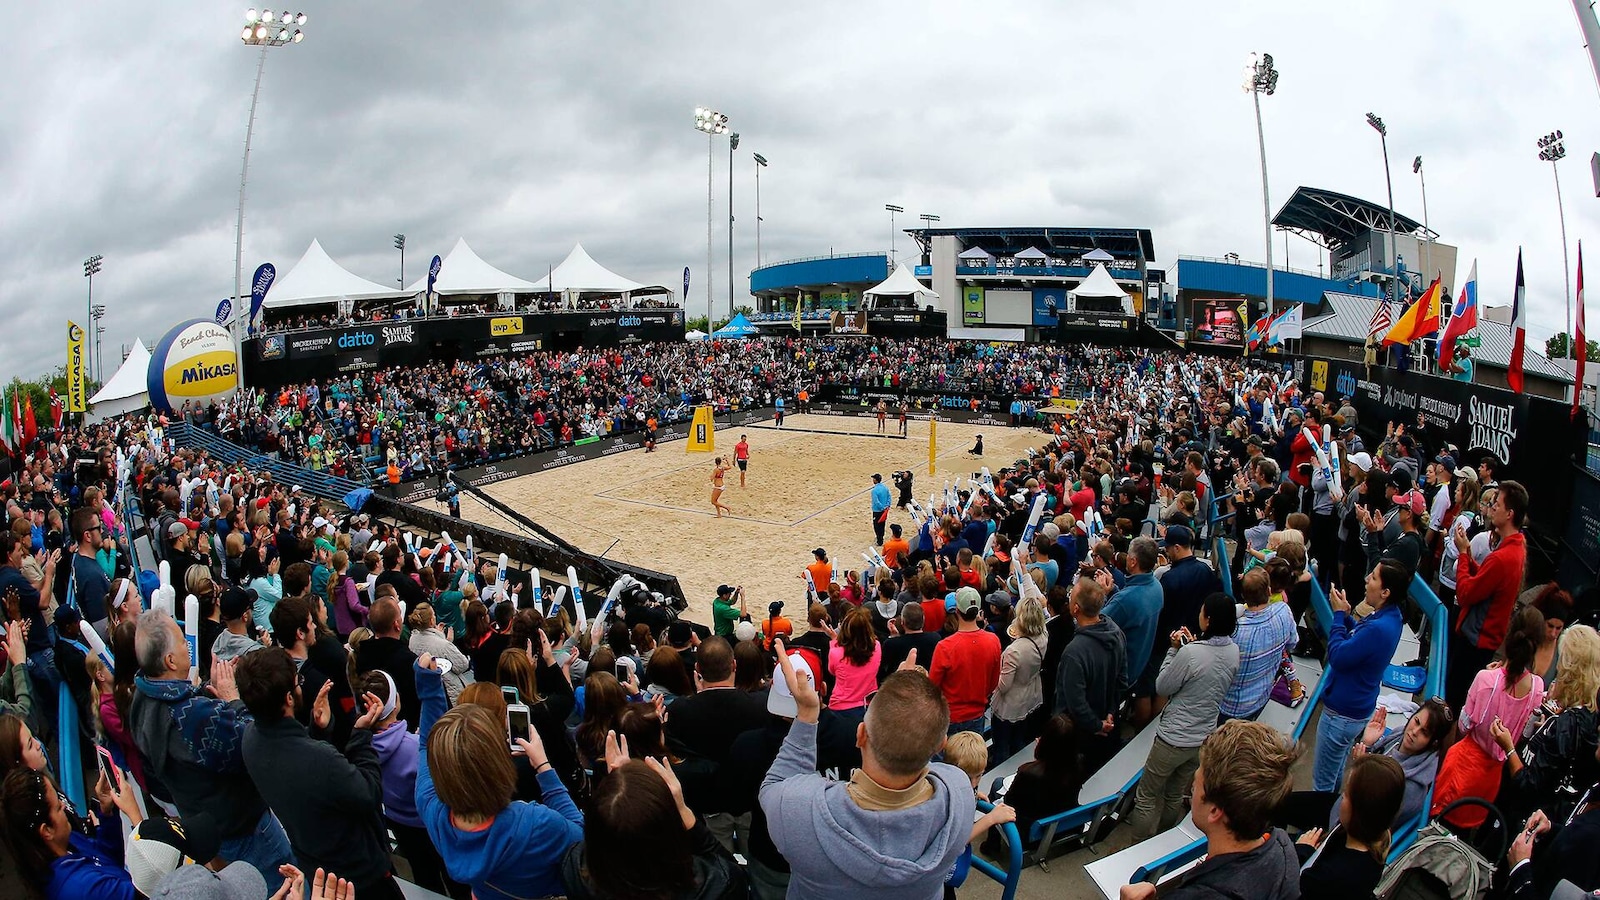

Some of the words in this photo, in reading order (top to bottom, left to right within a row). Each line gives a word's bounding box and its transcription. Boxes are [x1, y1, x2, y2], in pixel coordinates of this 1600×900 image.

[619, 315, 641, 326] datto
[382, 325, 415, 337] SAMUEL
[180, 331, 204, 349] Beach
[338, 331, 375, 348] datto
[384, 334, 412, 346] ADAMS
[1336, 369, 1355, 397] datto
[941, 395, 970, 407] datto
[1468, 395, 1517, 439] SAMUEL
[602, 446, 624, 455] WORLD
[1468, 424, 1510, 466] ADAMS
[543, 459, 568, 469] WORLD
[469, 475, 497, 486] WORLD
[498, 470, 518, 480] TOUR
